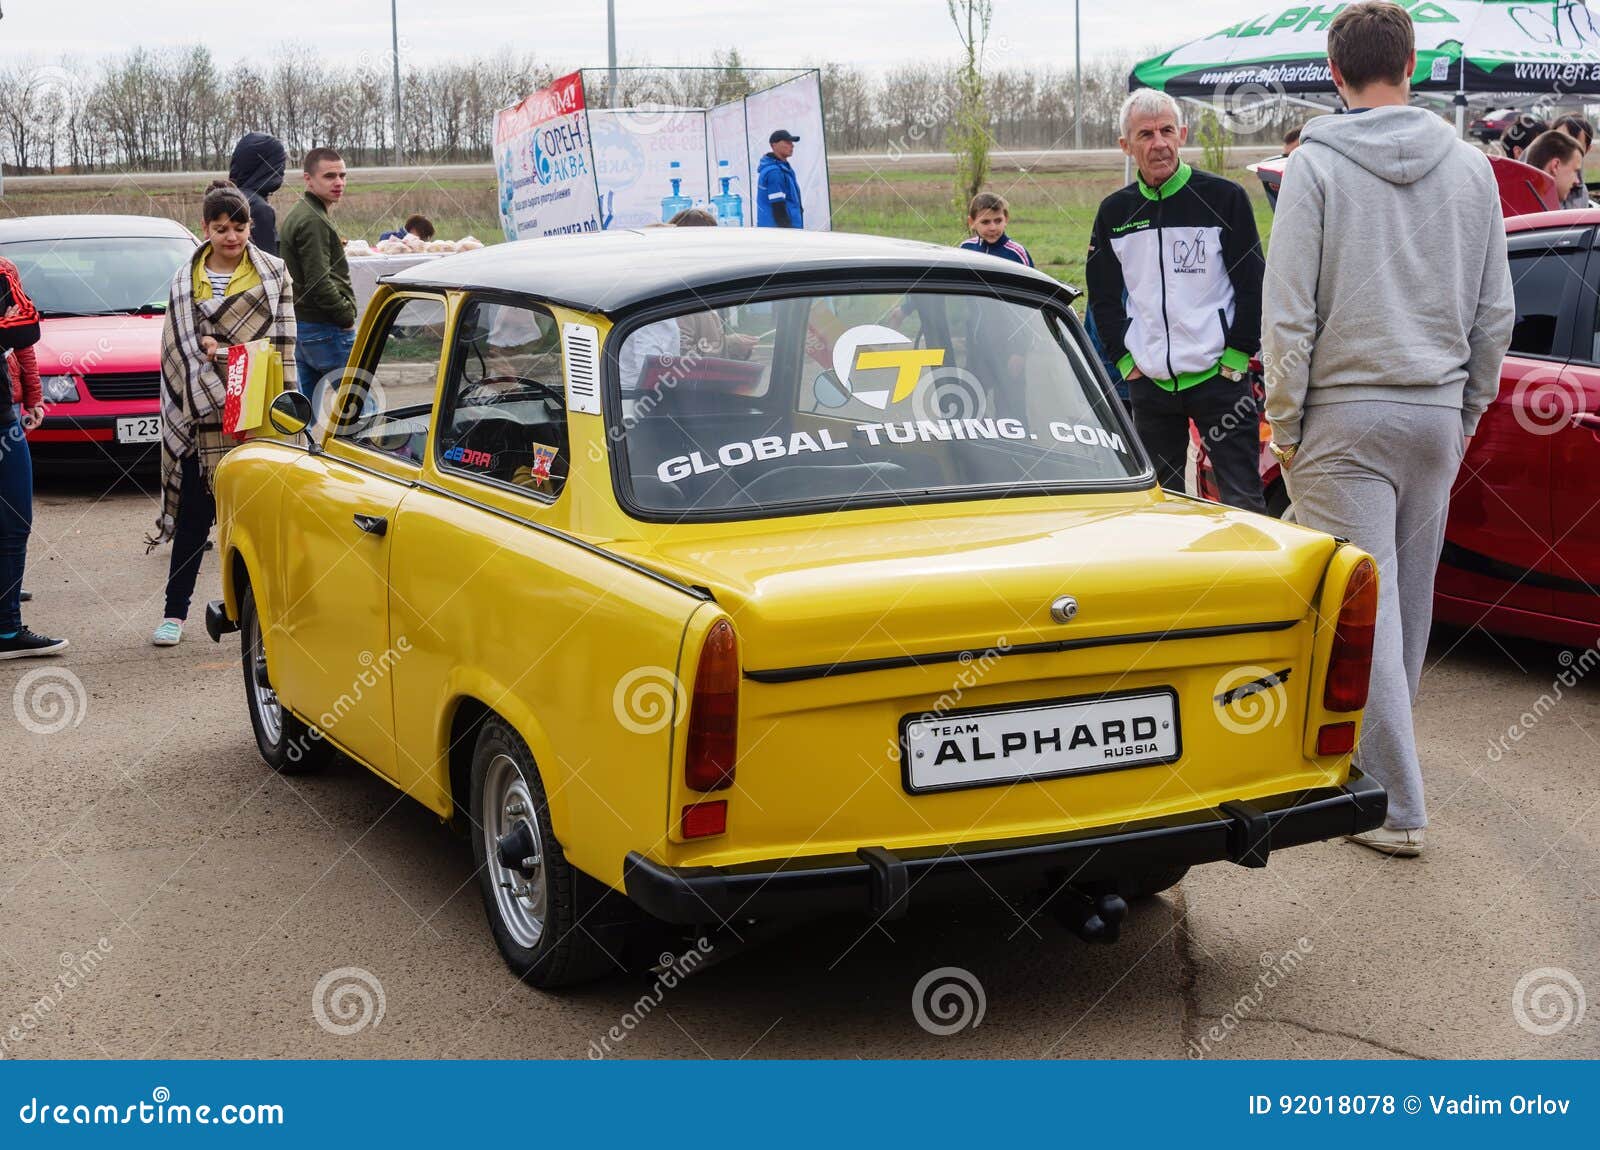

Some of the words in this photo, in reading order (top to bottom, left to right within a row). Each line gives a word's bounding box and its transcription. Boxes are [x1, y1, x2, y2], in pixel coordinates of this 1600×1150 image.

[544, 120, 583, 157] ОРЕН
[553, 152, 588, 181] АКВА
[656, 428, 848, 483] GLOBAL
[1049, 421, 1128, 454] COM
[931, 723, 979, 737] TEAM
[933, 716, 1157, 766] ALPHARD
[1104, 743, 1159, 759] RUSSIA
